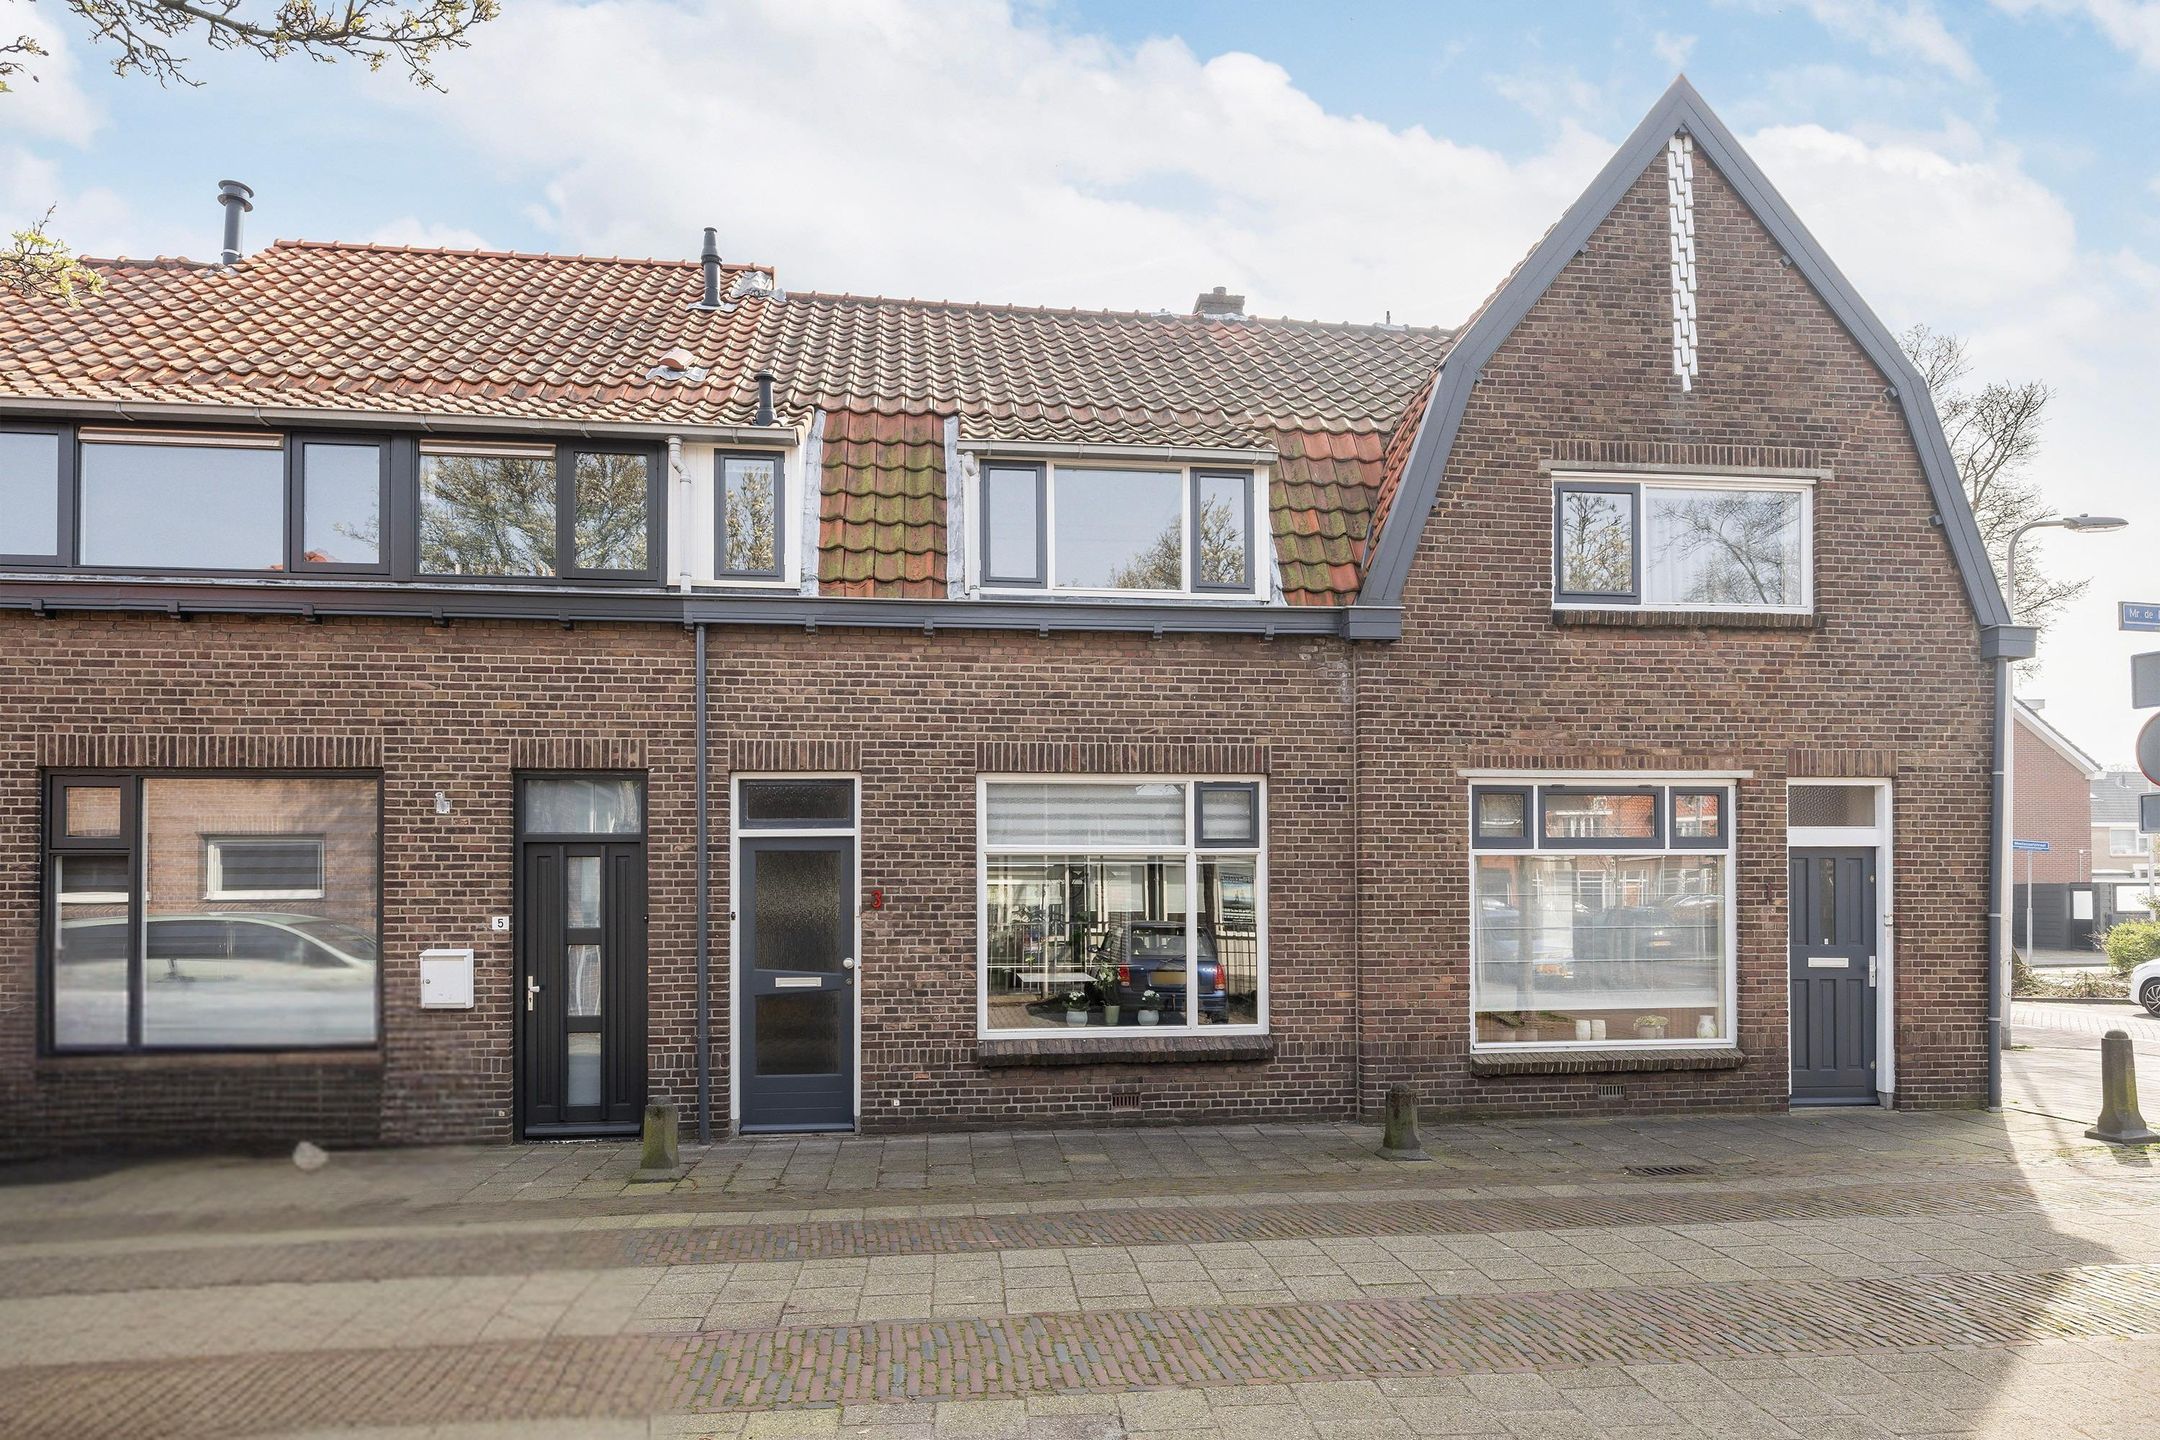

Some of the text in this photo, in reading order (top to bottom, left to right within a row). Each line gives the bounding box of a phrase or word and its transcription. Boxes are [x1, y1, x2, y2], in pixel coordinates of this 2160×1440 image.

[2144, 610, 2154, 619] de
[871, 889, 882, 909] 3
[497, 918, 504, 928] 5
